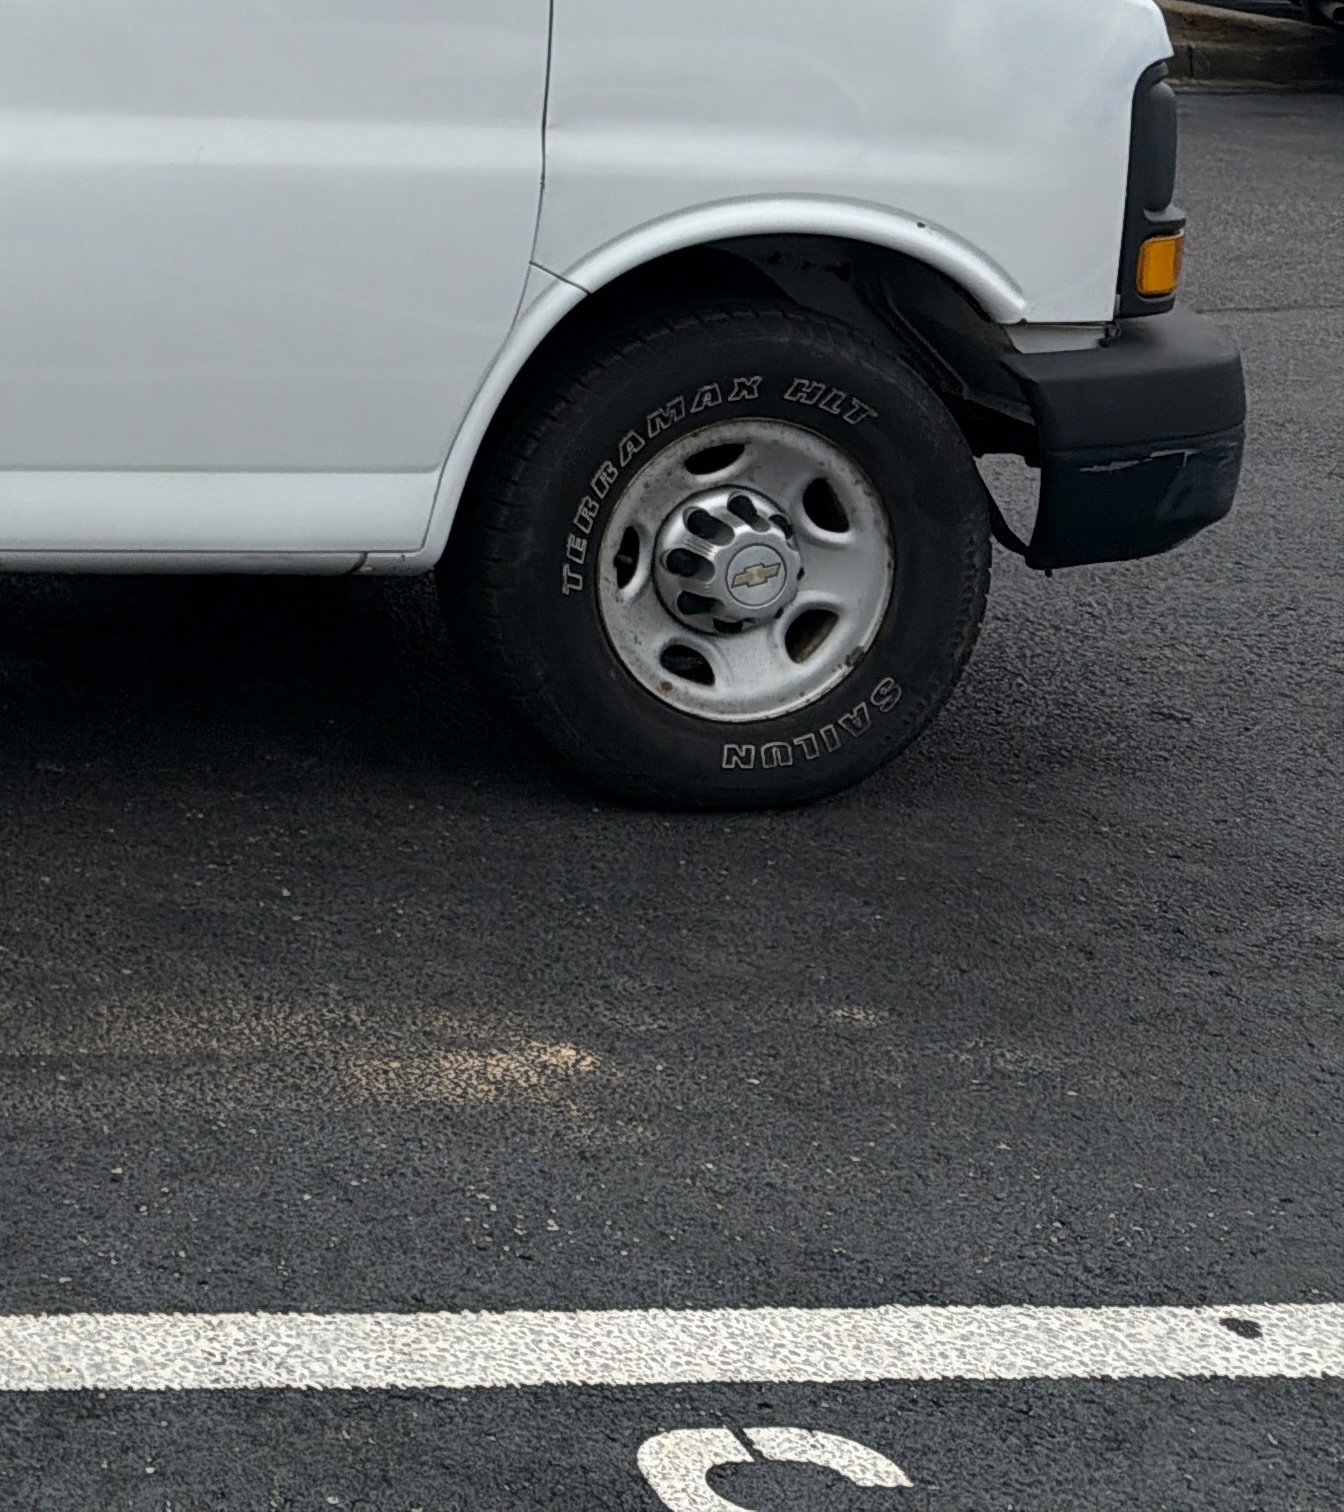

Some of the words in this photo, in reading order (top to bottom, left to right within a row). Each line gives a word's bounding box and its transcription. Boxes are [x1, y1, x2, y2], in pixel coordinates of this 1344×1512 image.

[563, 376, 762, 595] TERRAMAX
[784, 378, 879, 425] HLT
[722, 676, 903, 769] SAILUN
